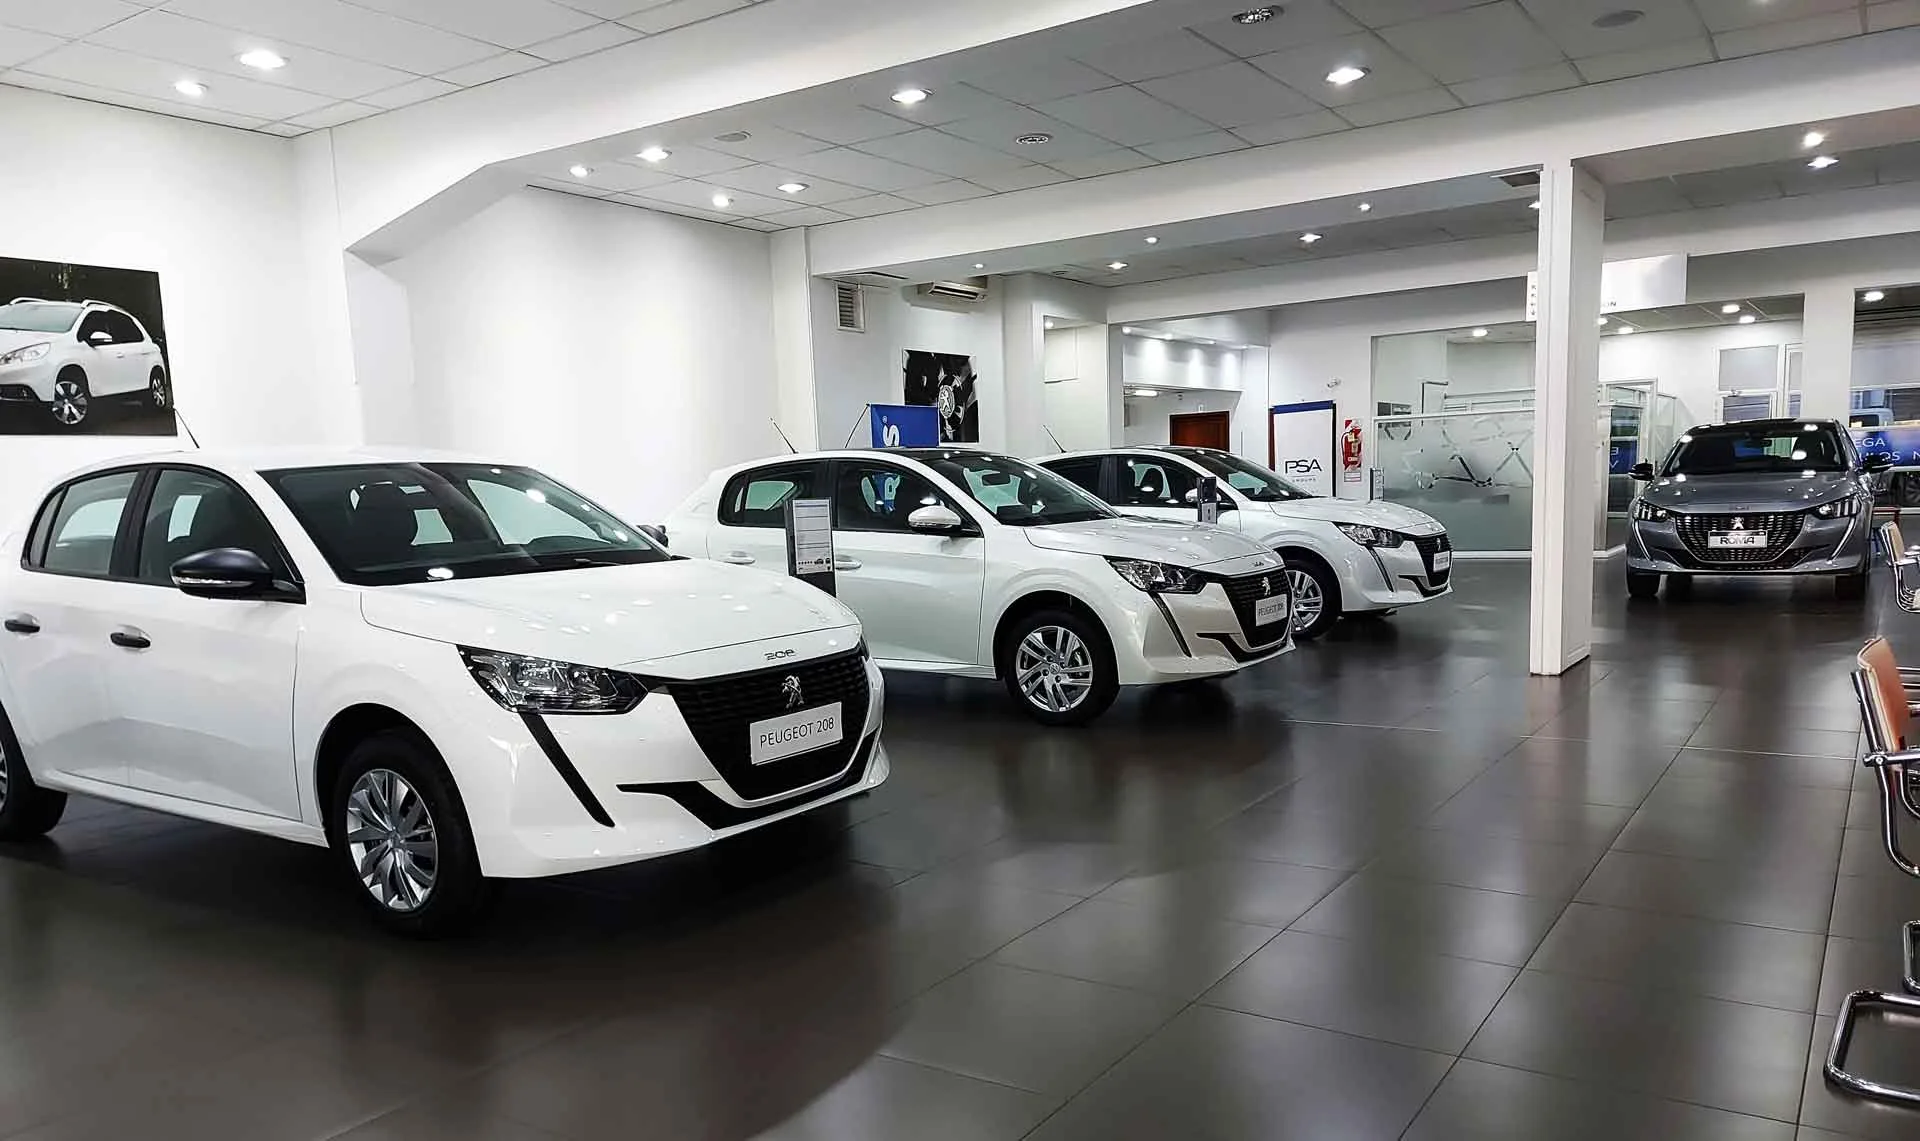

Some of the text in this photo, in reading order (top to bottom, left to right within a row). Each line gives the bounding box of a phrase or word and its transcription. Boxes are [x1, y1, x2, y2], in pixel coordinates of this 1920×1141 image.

[1284, 459, 1322, 474] PSA
[764, 649, 796, 660] 208
[760, 717, 834, 749] PEUGEOT 208
